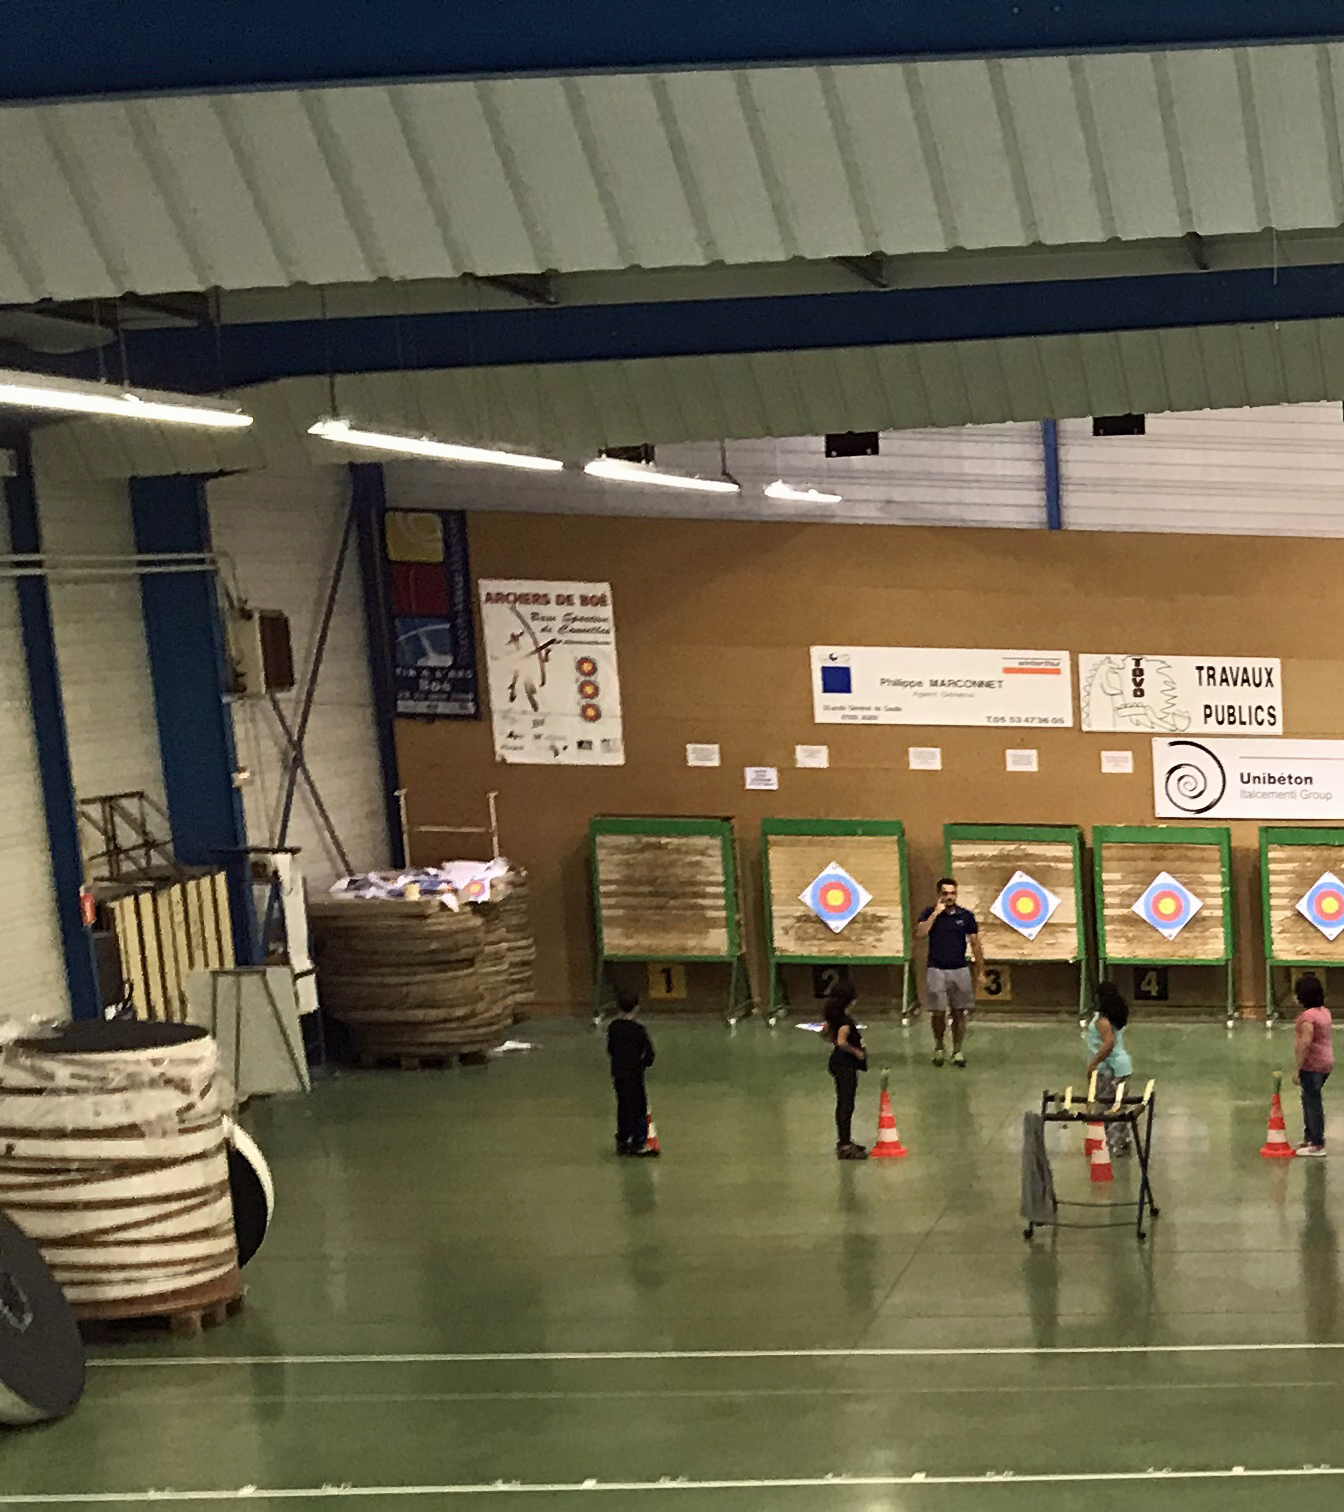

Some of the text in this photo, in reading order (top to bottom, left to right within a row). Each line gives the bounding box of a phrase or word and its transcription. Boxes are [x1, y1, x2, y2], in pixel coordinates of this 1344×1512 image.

[485, 592, 551, 605] ARCHERS
[555, 594, 575, 606] DE
[879, 677, 1004, 689] Philippe MARCONNET
[1196, 665, 1274, 688] TRAVAUX
[1203, 704, 1277, 726] PUBLICS
[1239, 771, 1313, 786] Unibéton
[1299, 789, 1333, 801] Group
[660, 967, 675, 993] 1
[821, 968, 840, 996] 2
[984, 969, 1002, 996] 3
[1140, 970, 1159, 997] 4
